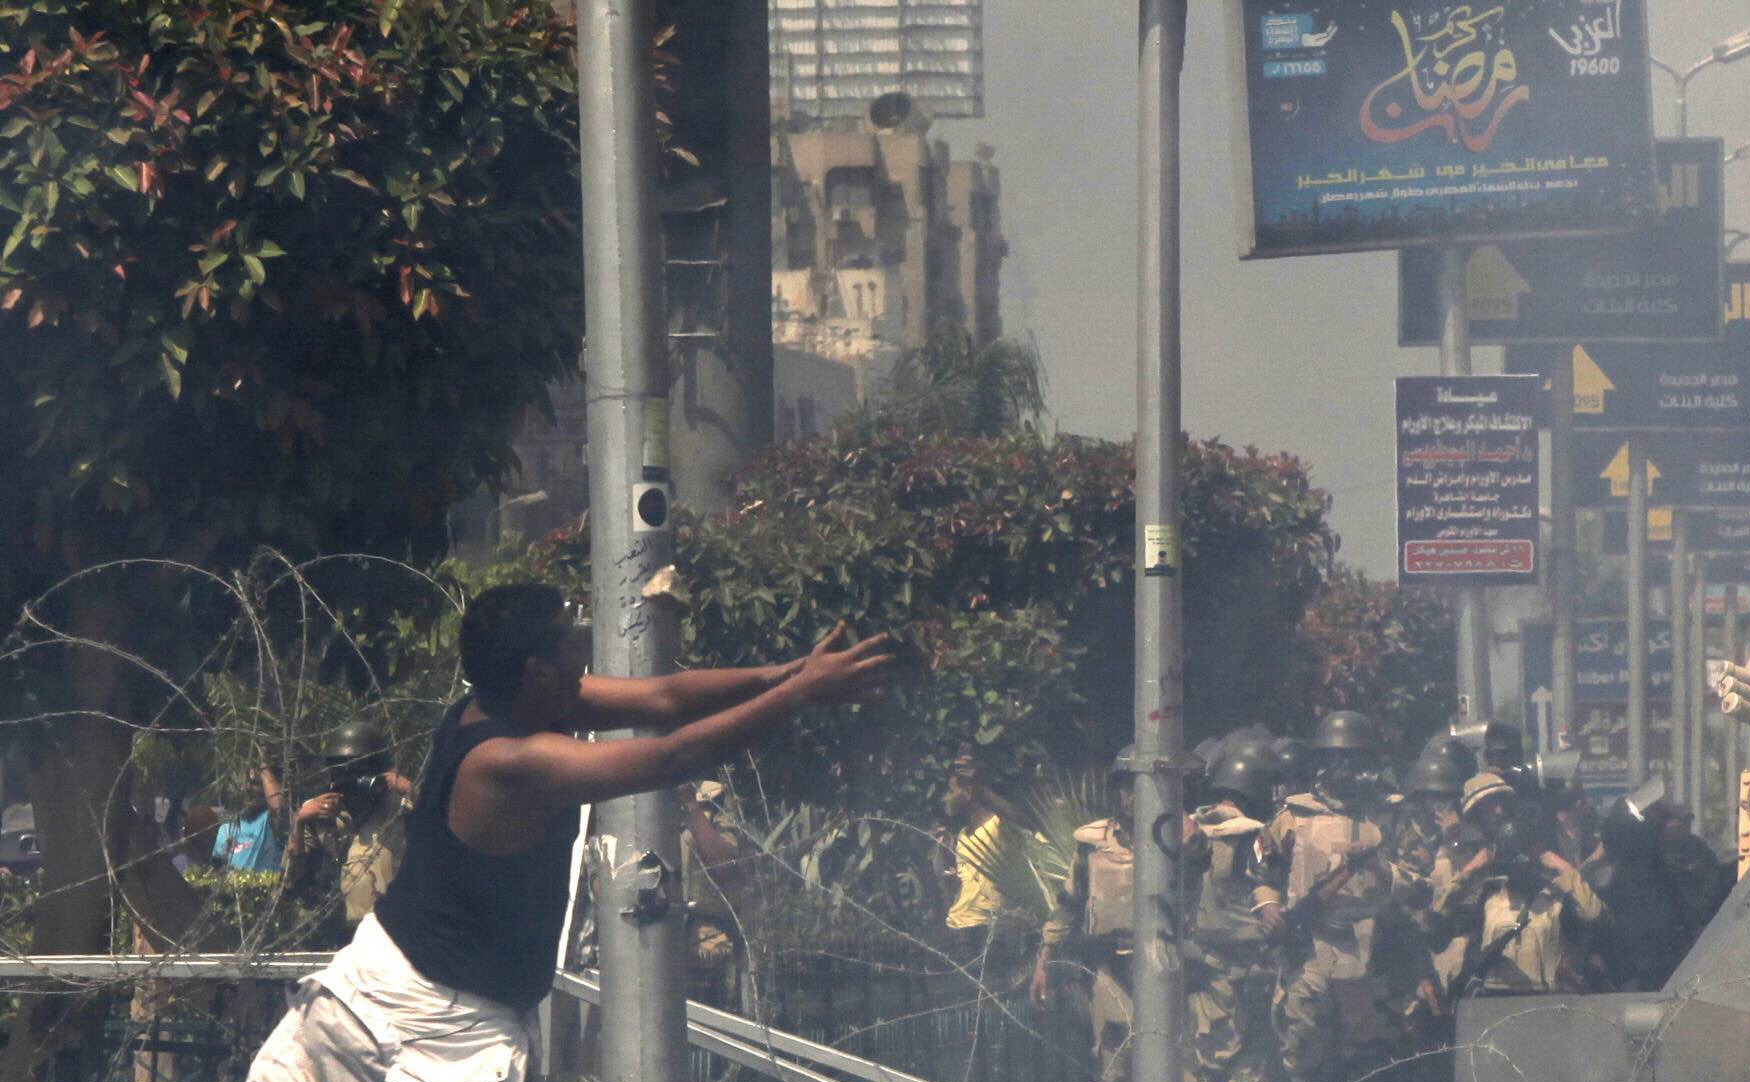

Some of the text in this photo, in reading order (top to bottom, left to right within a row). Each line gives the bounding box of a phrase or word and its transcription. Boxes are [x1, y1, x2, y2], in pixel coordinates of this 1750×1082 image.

[1569, 57, 1620, 76] 19600
[1360, 10, 1530, 152] رمضان
[1437, 387, 1498, 407] عيادة
[1477, 435, 1520, 463] أحمد
